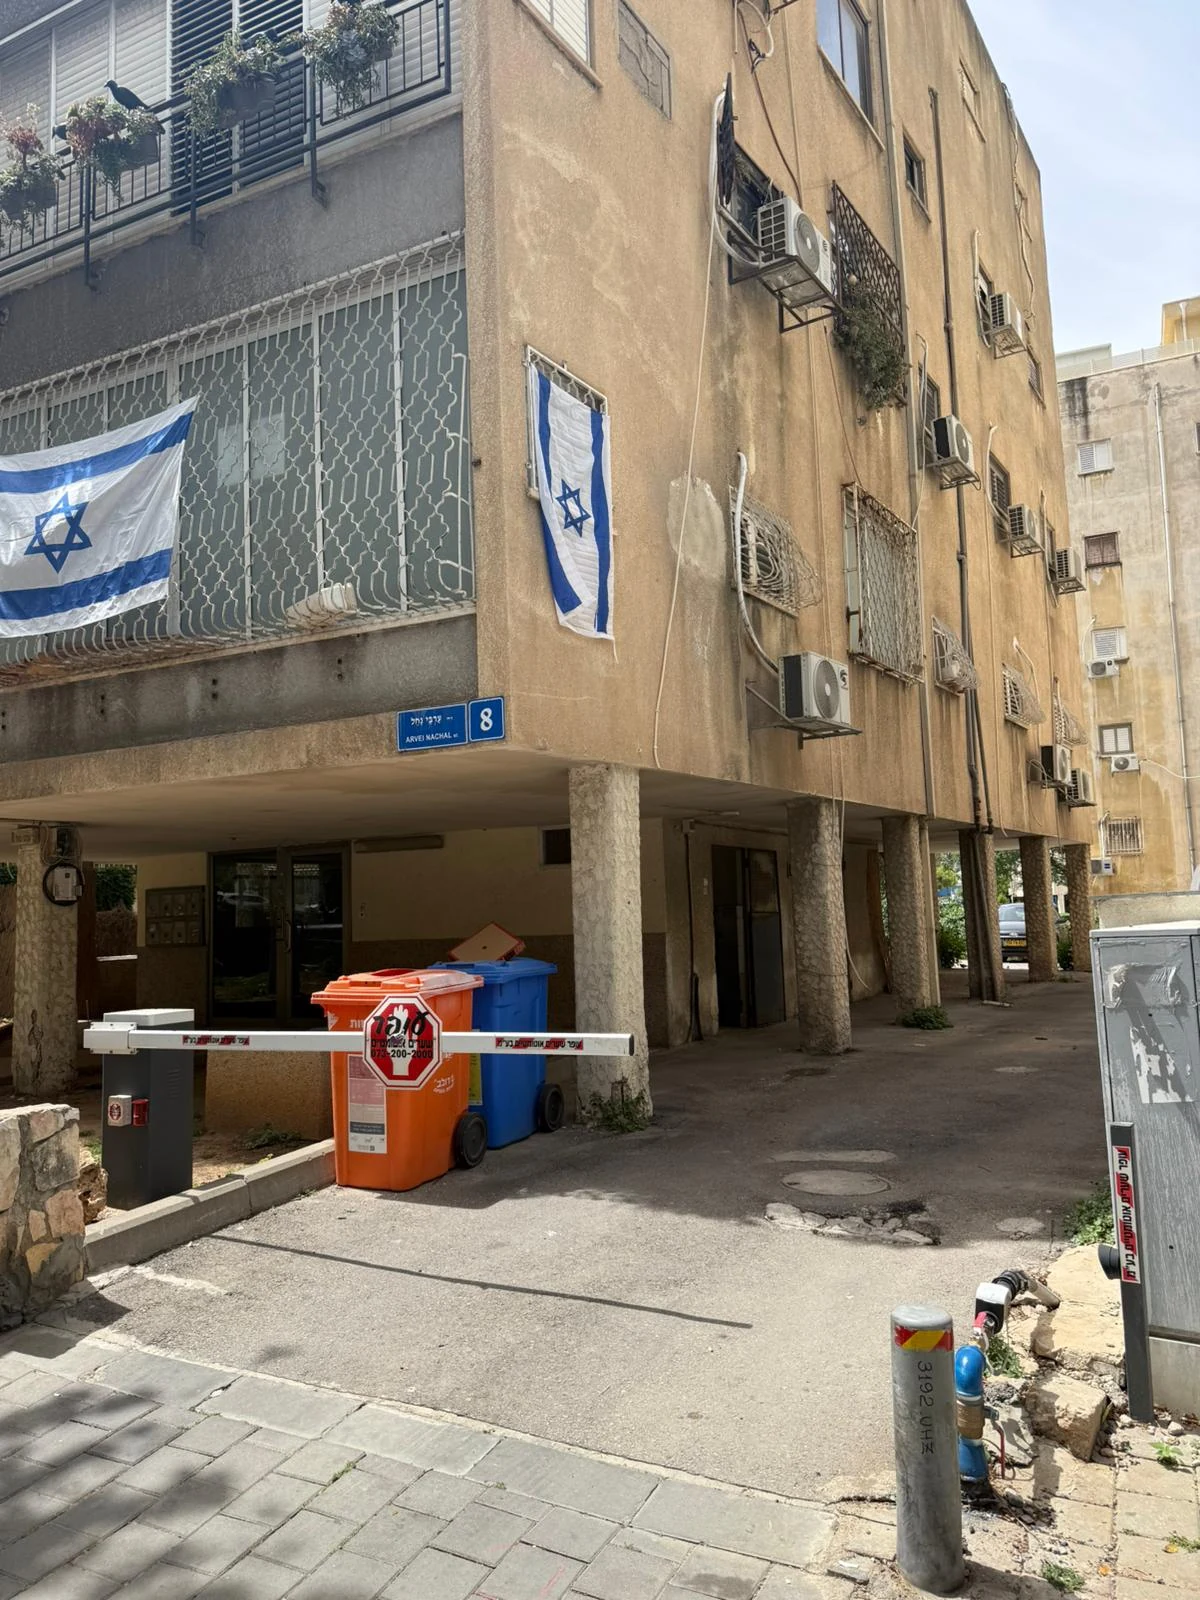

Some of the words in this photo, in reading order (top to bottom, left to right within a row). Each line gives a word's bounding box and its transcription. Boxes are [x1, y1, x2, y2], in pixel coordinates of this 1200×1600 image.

[480, 707, 493, 731] 8
[405, 735, 425, 743] ARVEI
[426, 732, 452, 741] NACHAL
[373, 1011, 430, 1036] עופר
[371, 1049, 433, 1058] 073-200-2000
[1117, 1150, 1129, 1170] עופר
[1119, 1173, 1130, 1203] שערים
[1121, 1205, 1134, 1251] אוטומטיים
[1125, 1253, 1136, 1278] בע"מ
[918, 1360, 934, 1407] 3192
